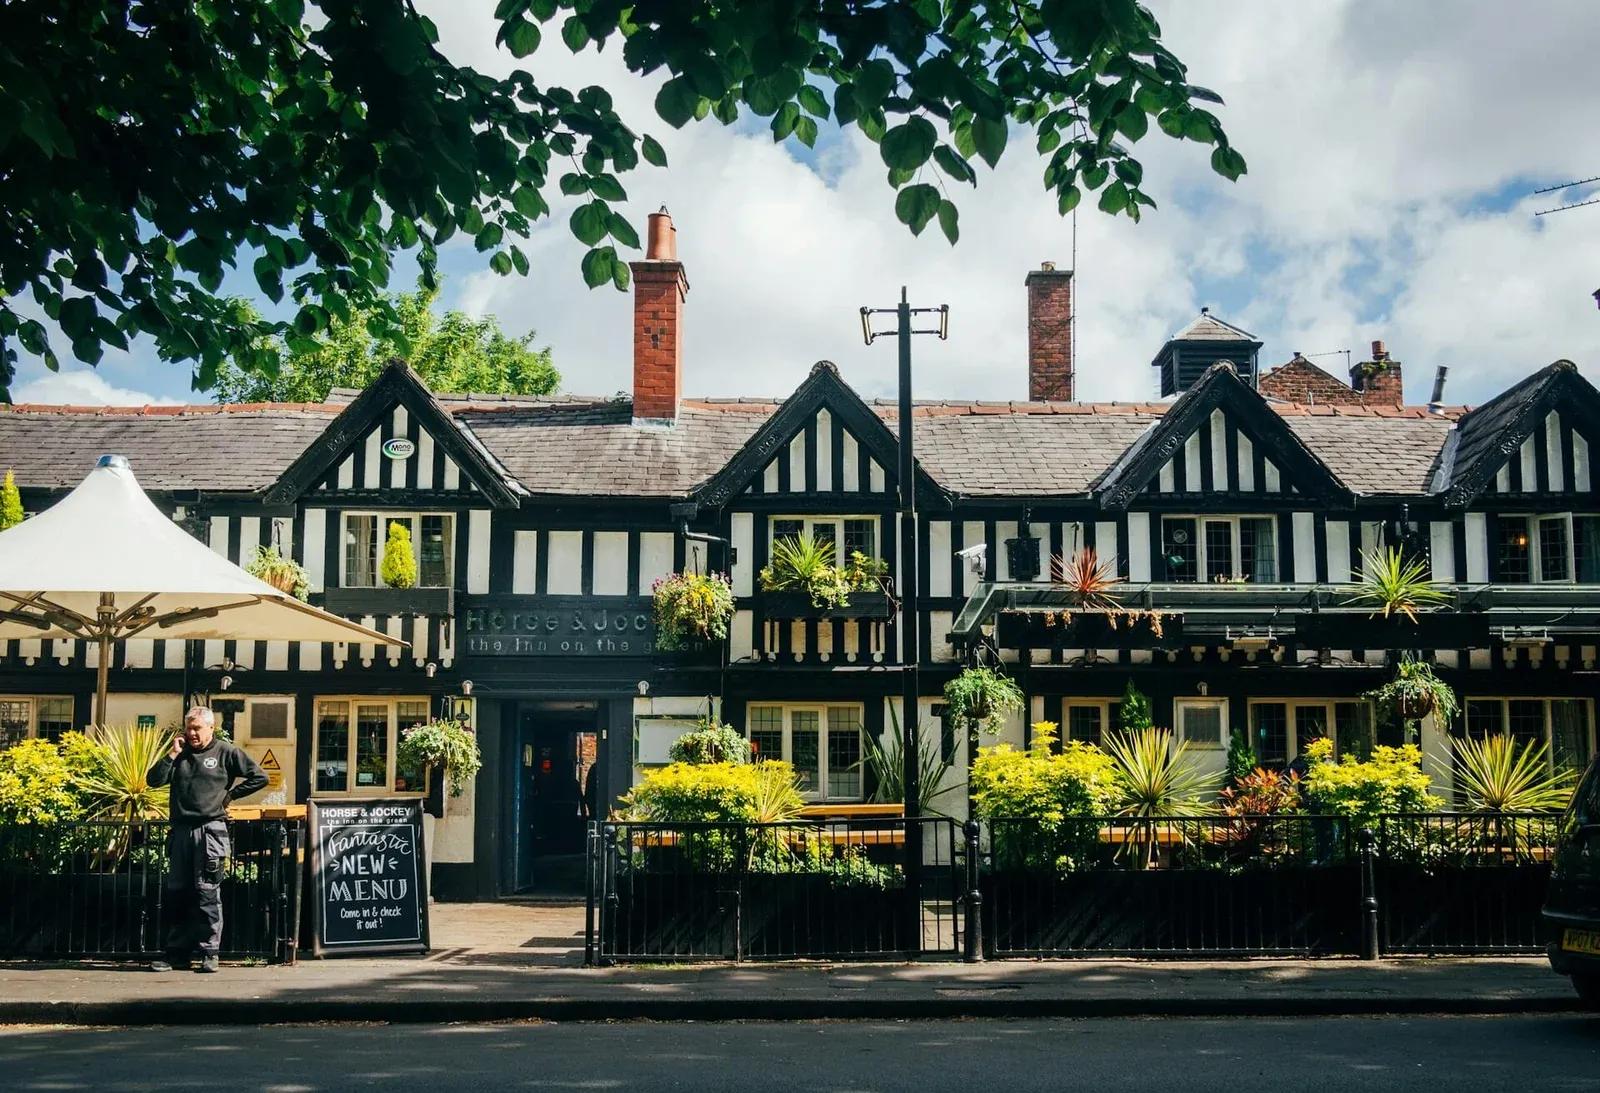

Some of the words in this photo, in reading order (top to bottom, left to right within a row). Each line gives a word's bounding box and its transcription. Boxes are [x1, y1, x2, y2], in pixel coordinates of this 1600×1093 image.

[466, 609, 560, 631] Horse
[571, 611, 587, 631] &
[593, 609, 648, 631] Joc
[470, 637, 502, 652] the
[560, 640, 584, 652] on
[596, 638, 629, 652] the
[643, 641, 703, 654] gen
[321, 807, 358, 818] HORSE
[360, 808, 368, 817] &
[369, 807, 411, 817] JOCKEY
[342, 854, 385, 875] NEW
[328, 878, 408, 902] MENU
[340, 907, 361, 919] Come
[362, 907, 370, 918] in
[372, 906, 379, 917] &
[380, 905, 402, 917] check
[356, 919, 364, 930] it
